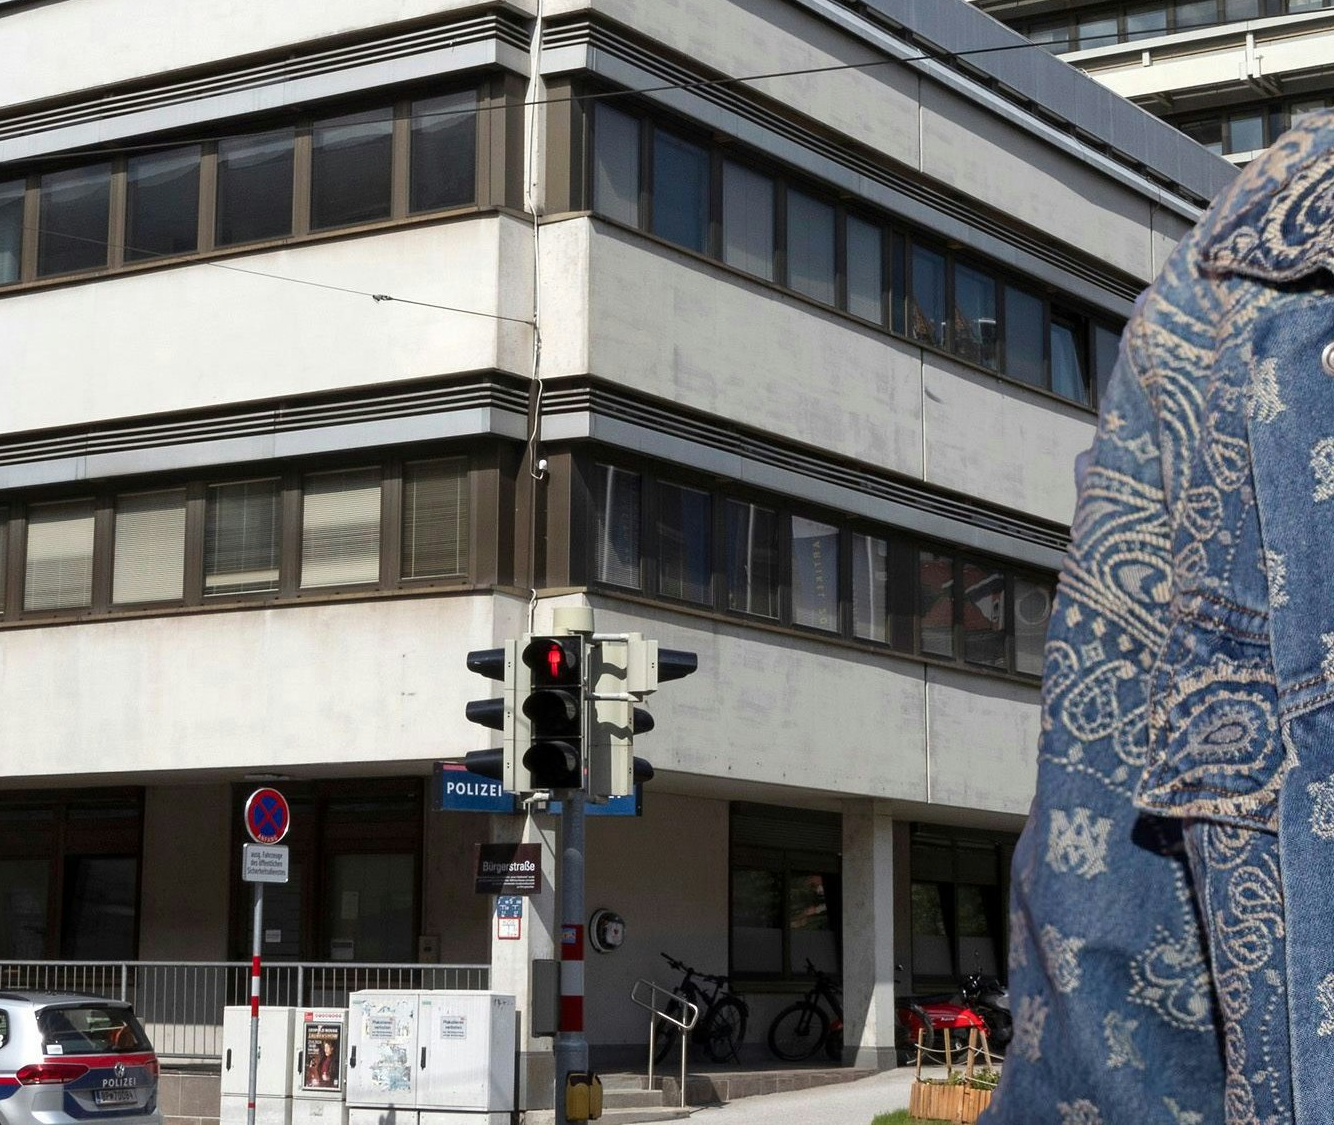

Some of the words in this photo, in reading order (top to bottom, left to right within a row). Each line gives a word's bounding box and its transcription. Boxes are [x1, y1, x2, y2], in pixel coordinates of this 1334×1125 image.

[446, 782, 502, 797] POLIZEI
[482, 860, 535, 874] Bürgerstraße
[102, 1077, 137, 1087] POLIZEI
